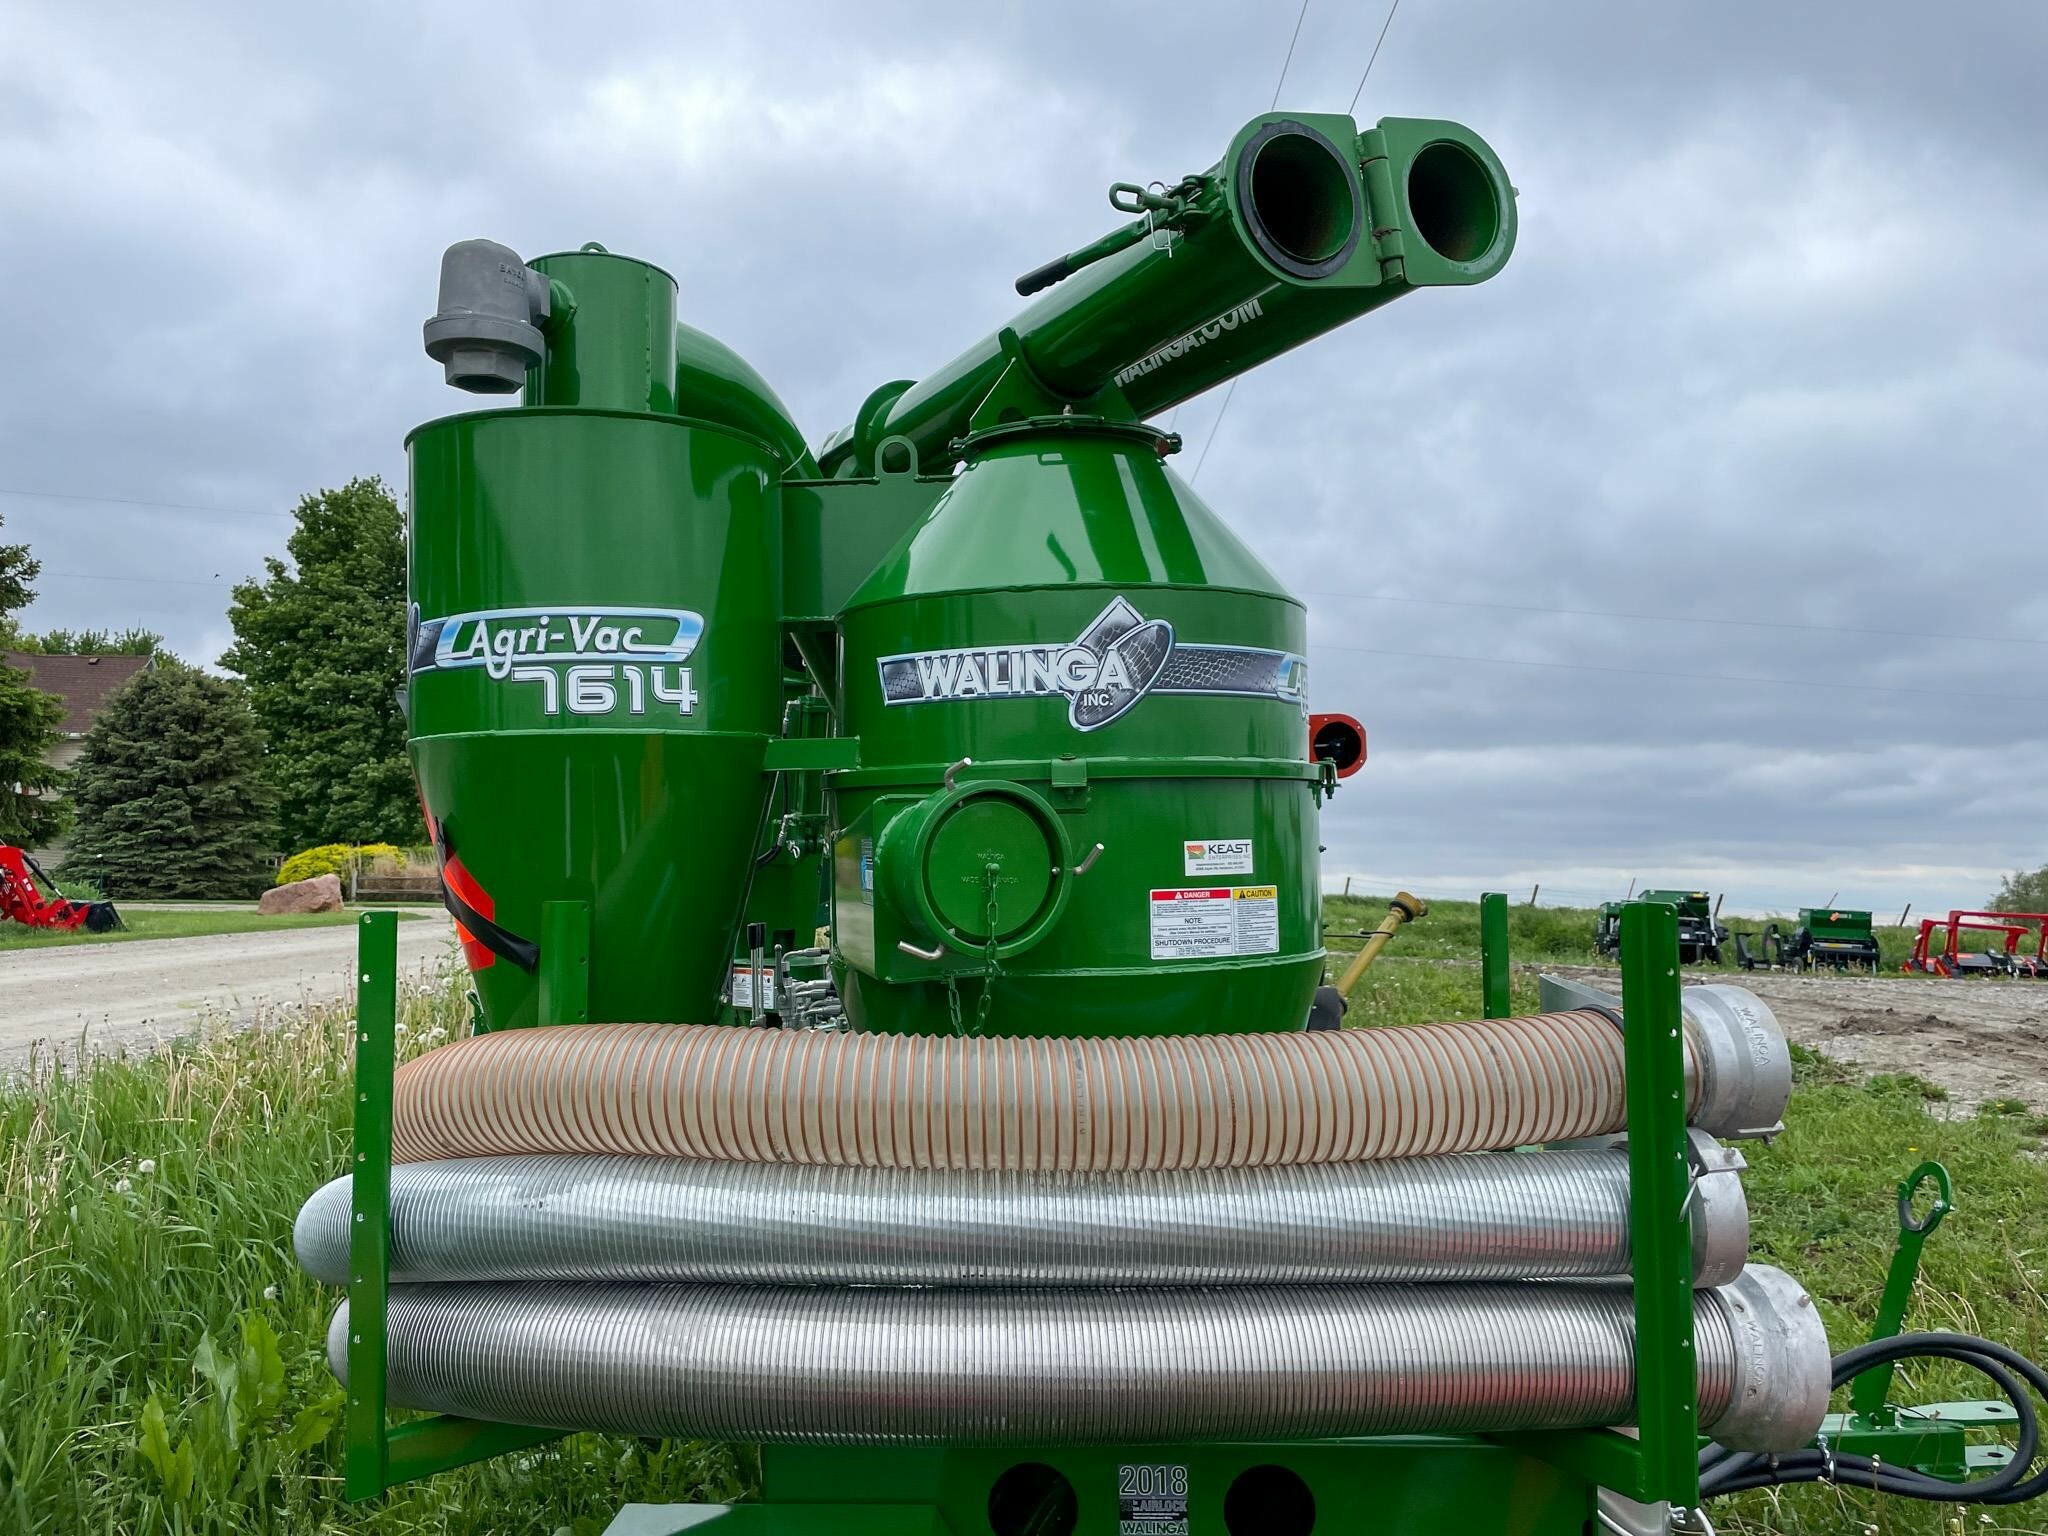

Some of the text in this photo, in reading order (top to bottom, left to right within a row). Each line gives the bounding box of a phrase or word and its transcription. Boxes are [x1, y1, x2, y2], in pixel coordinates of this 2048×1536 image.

[1114, 299, 1263, 388] WALINGA.COM
[463, 615, 644, 679] Agri-Vac
[916, 645, 1133, 698] WALINGA
[511, 665, 698, 715] 7614
[1083, 693, 1114, 707] INC.
[1208, 843, 1250, 854] KEAST
[1183, 891, 1210, 899] DANGER
[1246, 889, 1272, 898] CAUTION
[1194, 937, 1231, 945] PROCEDURE
[1119, 1465, 1188, 1495] 2018
[1120, 1520, 1189, 1536] WALINGA
